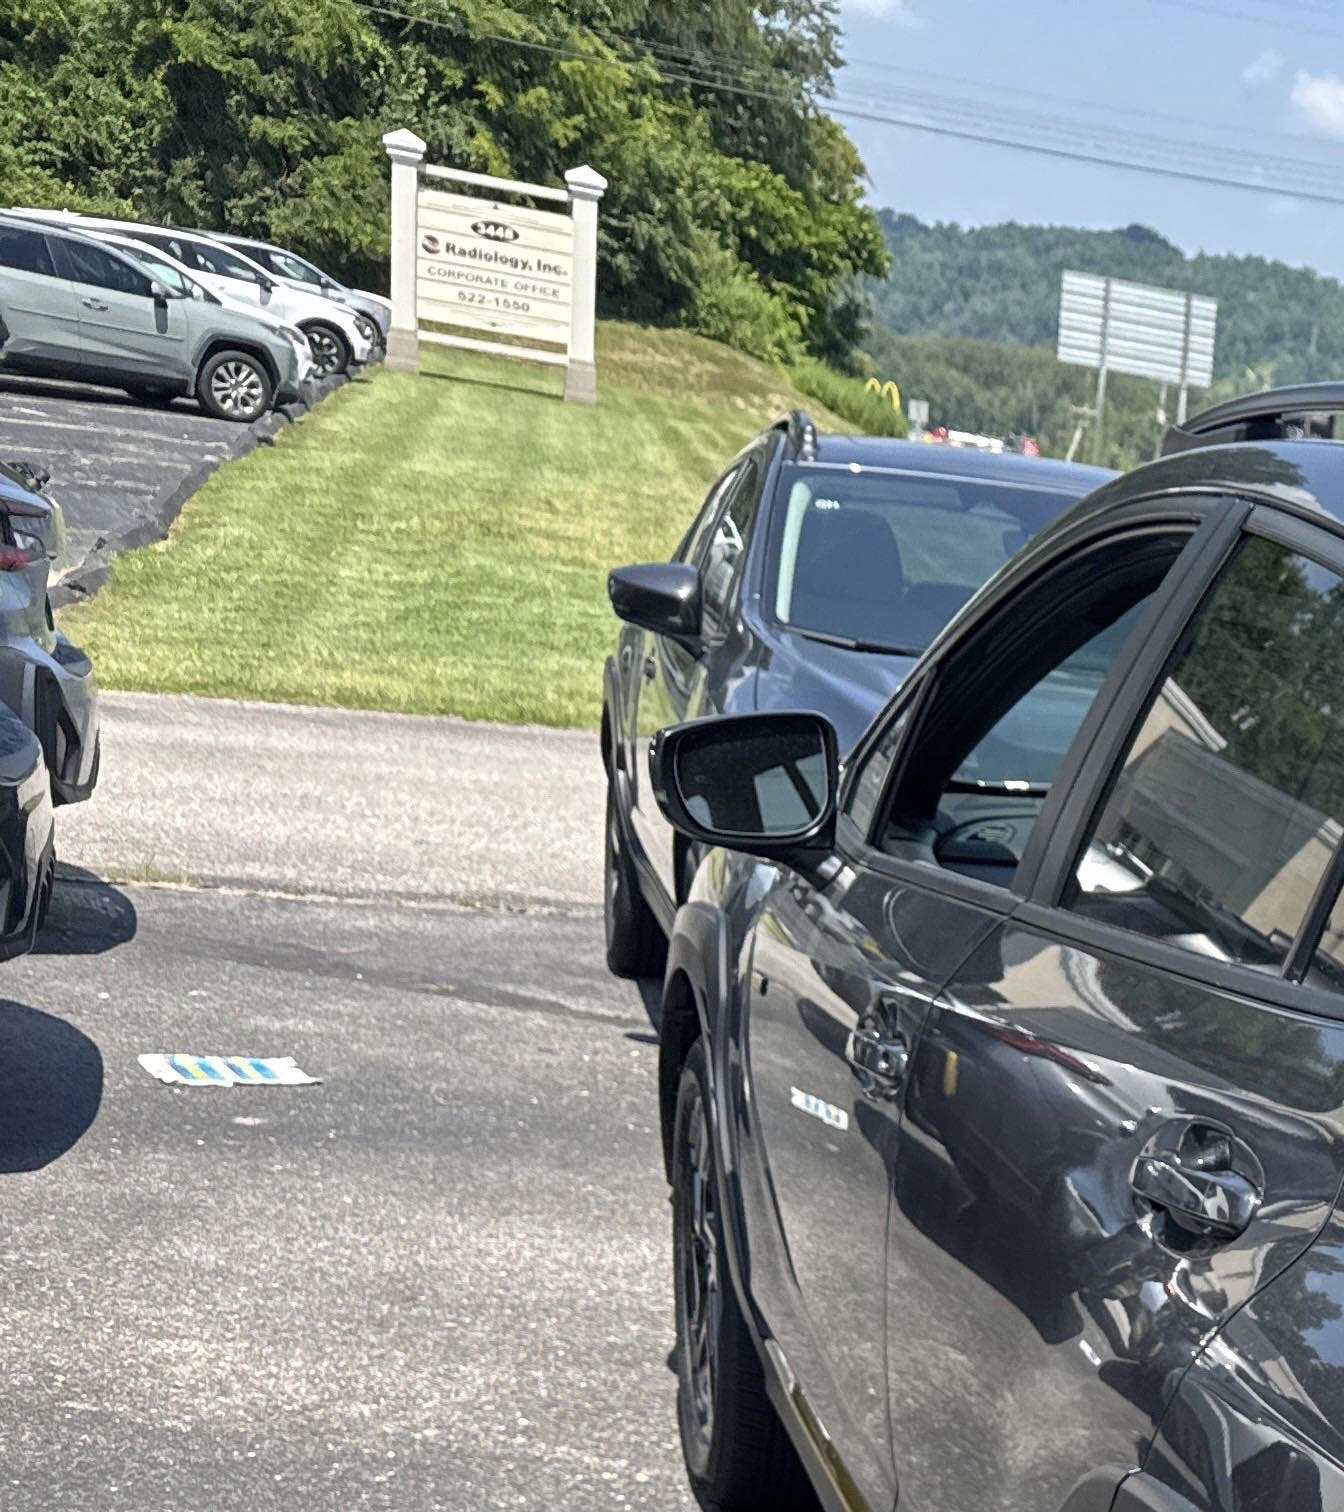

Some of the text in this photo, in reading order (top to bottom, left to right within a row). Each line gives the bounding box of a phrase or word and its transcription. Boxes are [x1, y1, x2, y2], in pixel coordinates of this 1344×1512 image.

[445, 242, 569, 277] Radiology, Inc.
[427, 265, 560, 299] CORPORATE OFFICE
